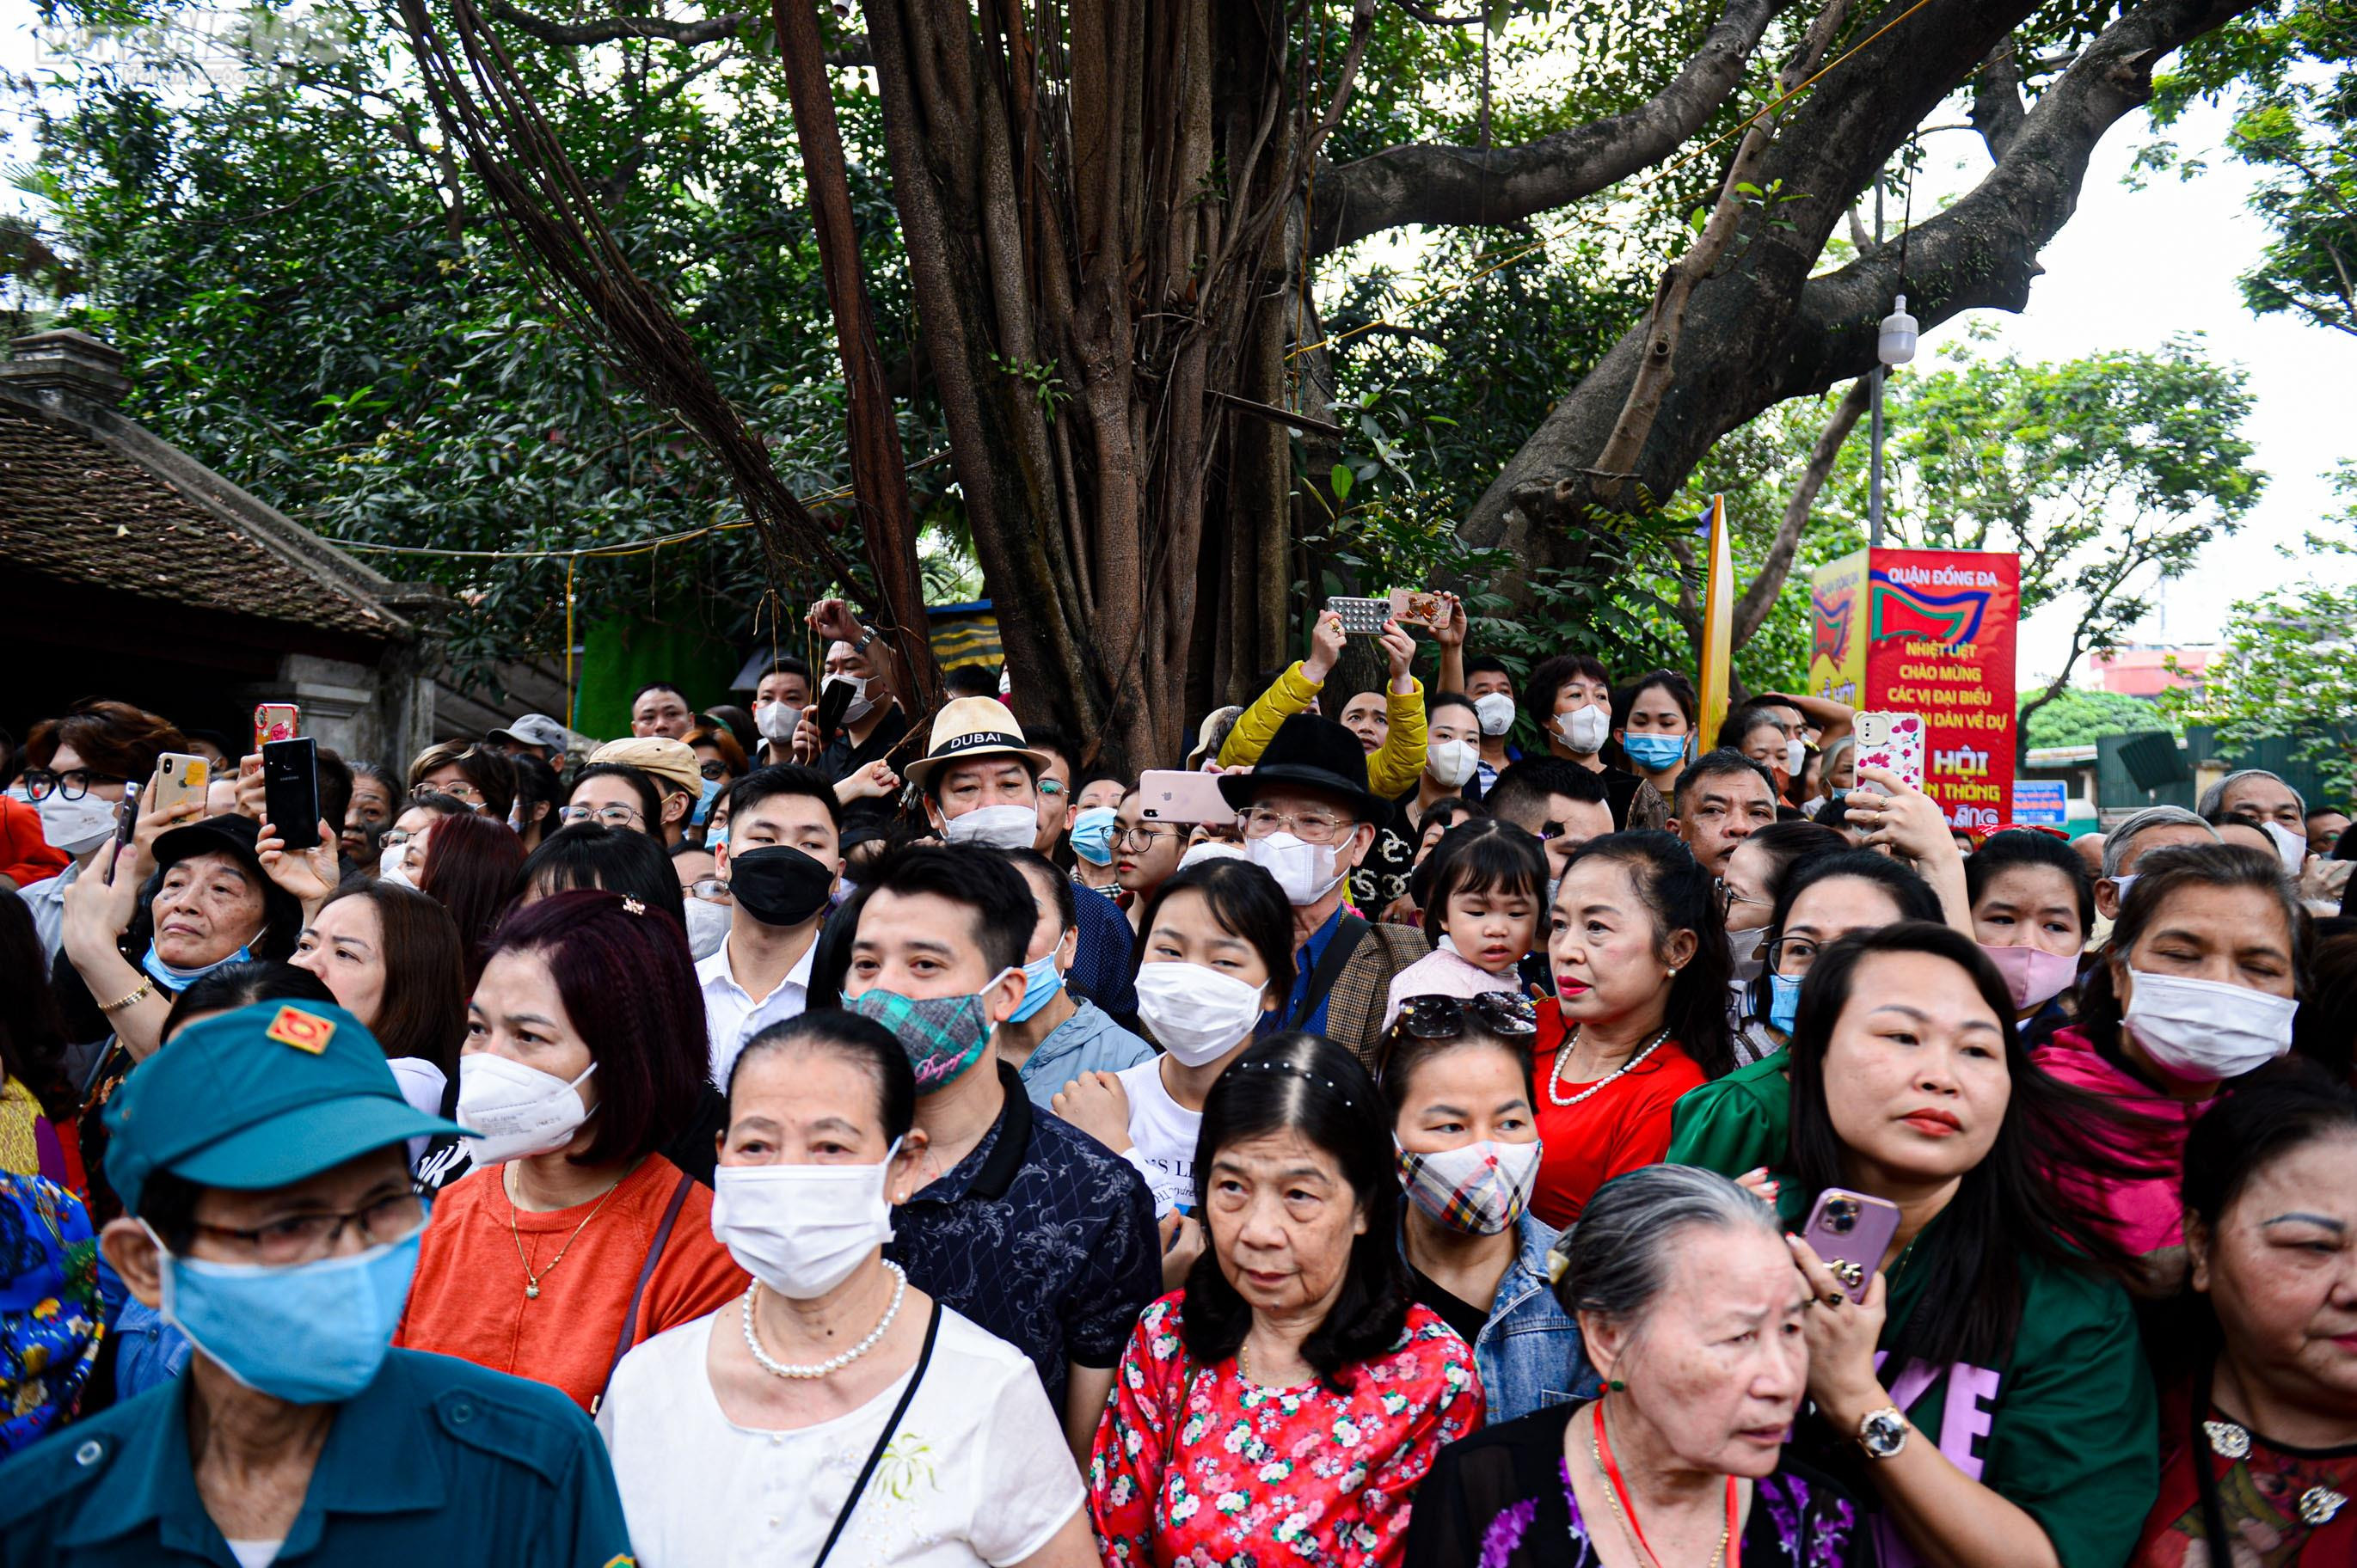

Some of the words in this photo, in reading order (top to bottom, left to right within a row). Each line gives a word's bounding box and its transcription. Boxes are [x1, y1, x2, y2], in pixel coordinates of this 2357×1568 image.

[1887, 565, 1930, 587] QUẬN
[1932, 564, 1975, 586] ĐỐNG
[1976, 571, 1998, 587] ĐA
[1906, 640, 1947, 659] NHIỆT
[1948, 640, 1978, 660] LIỆT
[1899, 662, 1937, 680] CHÀO
[1887, 685, 1915, 702] CÁC
[1917, 689, 1931, 707] VỊ
[1933, 689, 1957, 707] ĐẠI
[1959, 686, 1992, 705] BIỂU
[1934, 710, 1963, 728] DÂN
[1966, 709, 1985, 729] VỀ
[1986, 714, 2009, 732] DỰ
[950, 732, 1001, 750] DUBAI
[1933, 744, 1989, 781] HỘI
[1943, 779, 2001, 803] THỐNG
